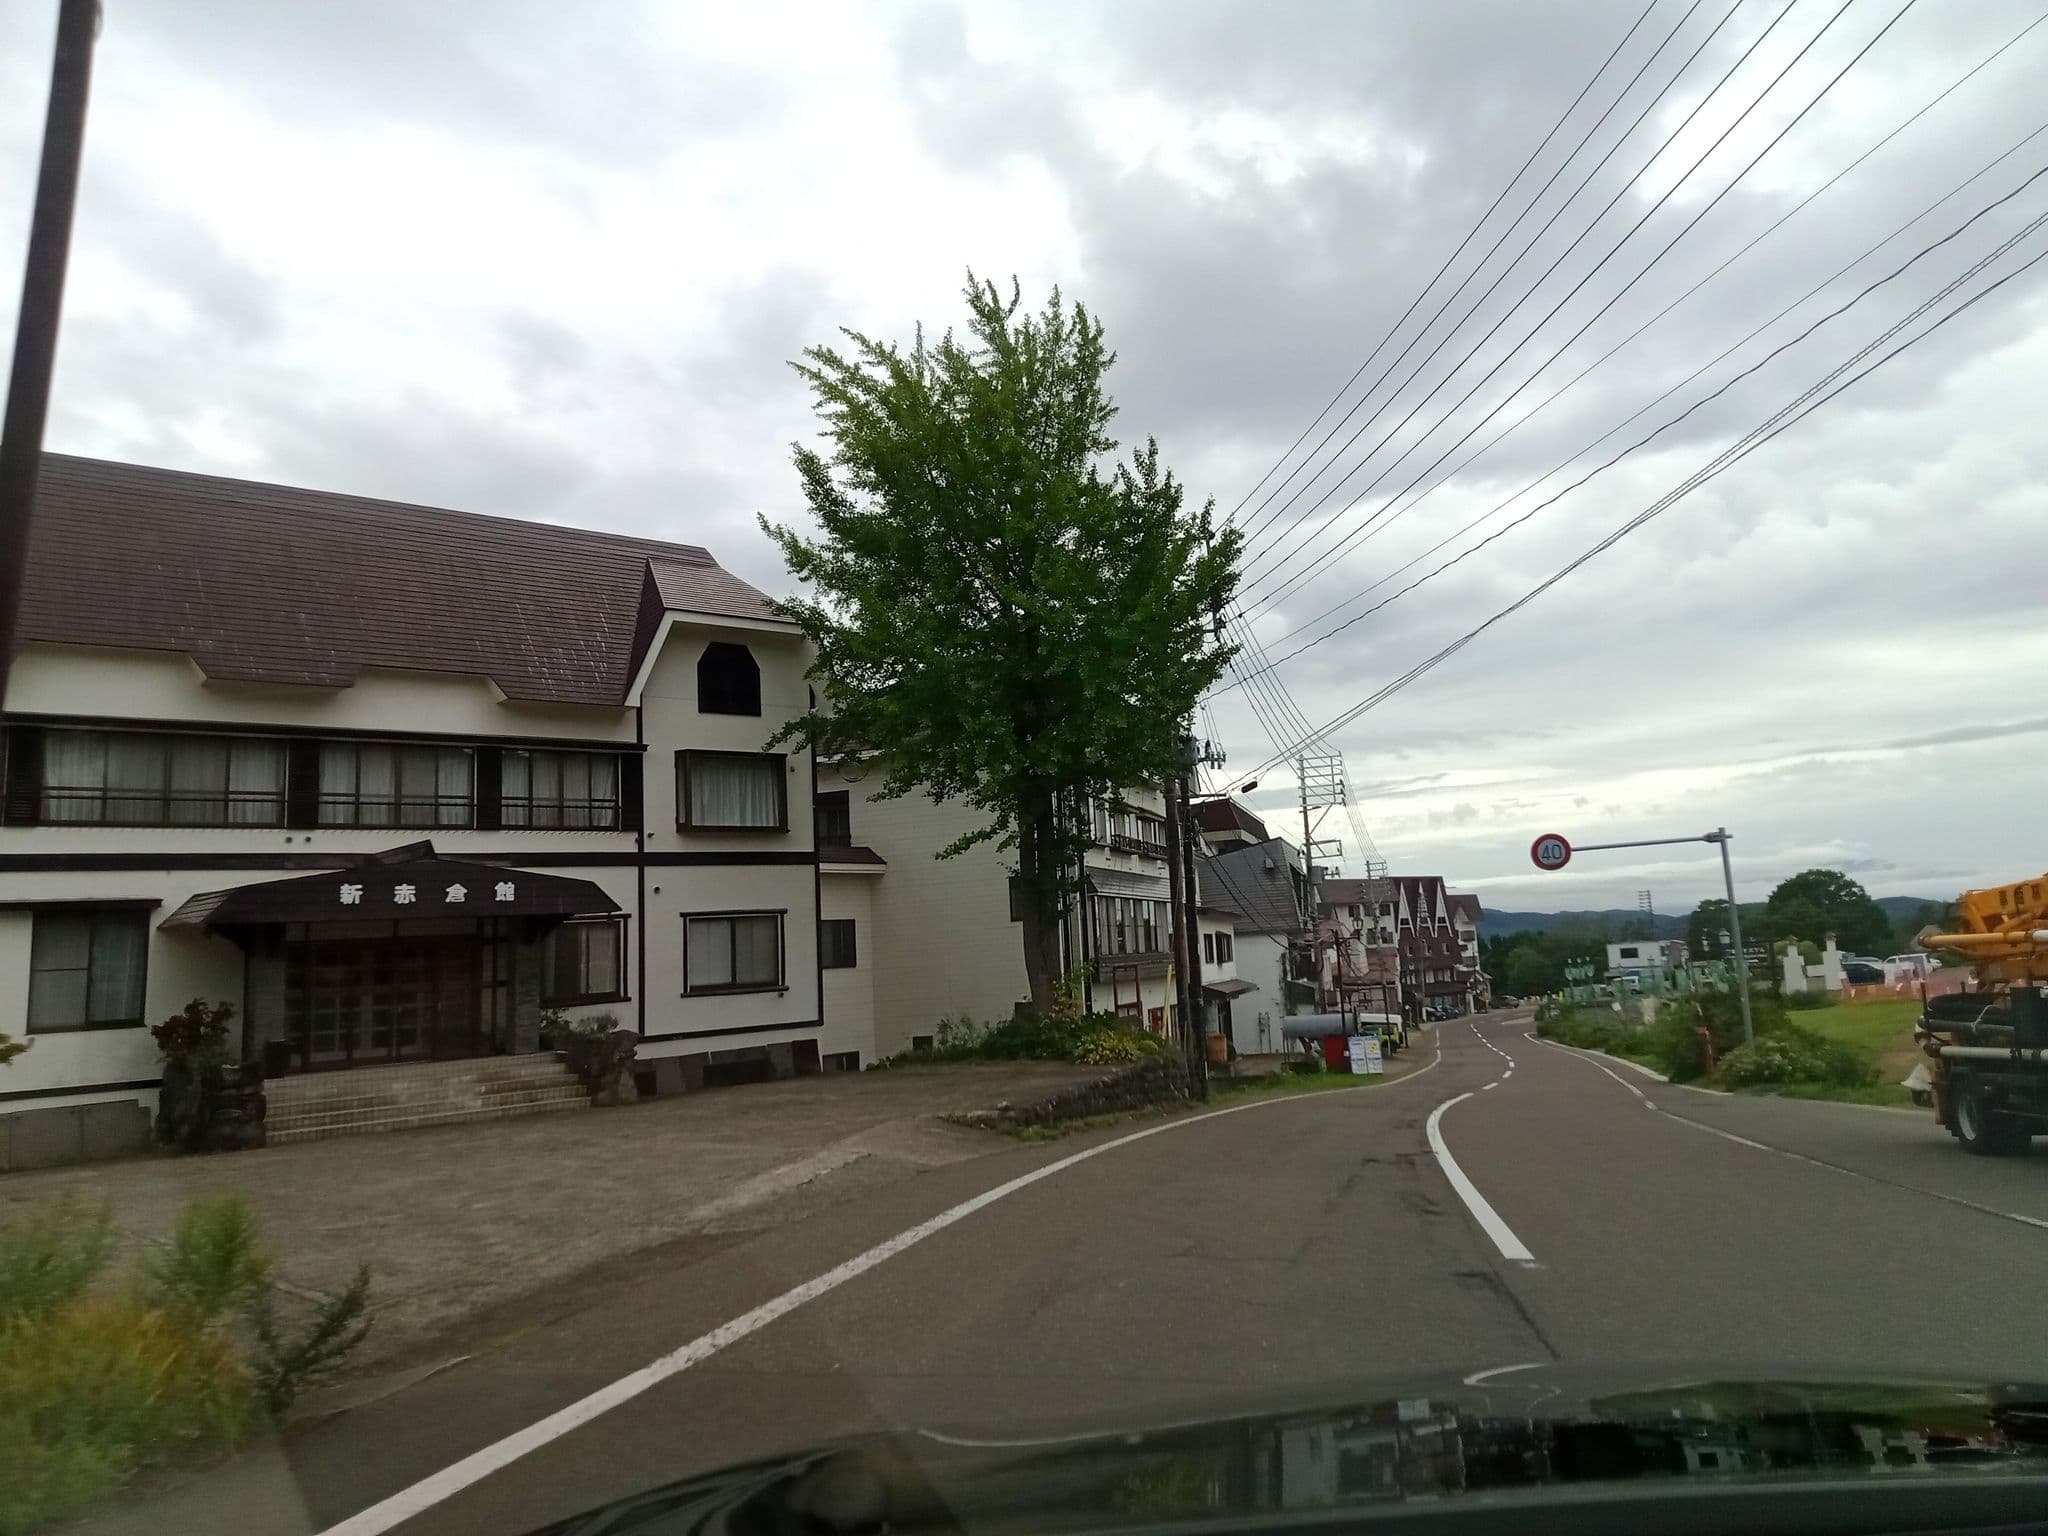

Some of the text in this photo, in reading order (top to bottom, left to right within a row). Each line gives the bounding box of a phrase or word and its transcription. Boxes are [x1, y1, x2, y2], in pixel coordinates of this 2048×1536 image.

[1542, 844, 1563, 861] 40
[339, 881, 515, 905] 新赤倉館
